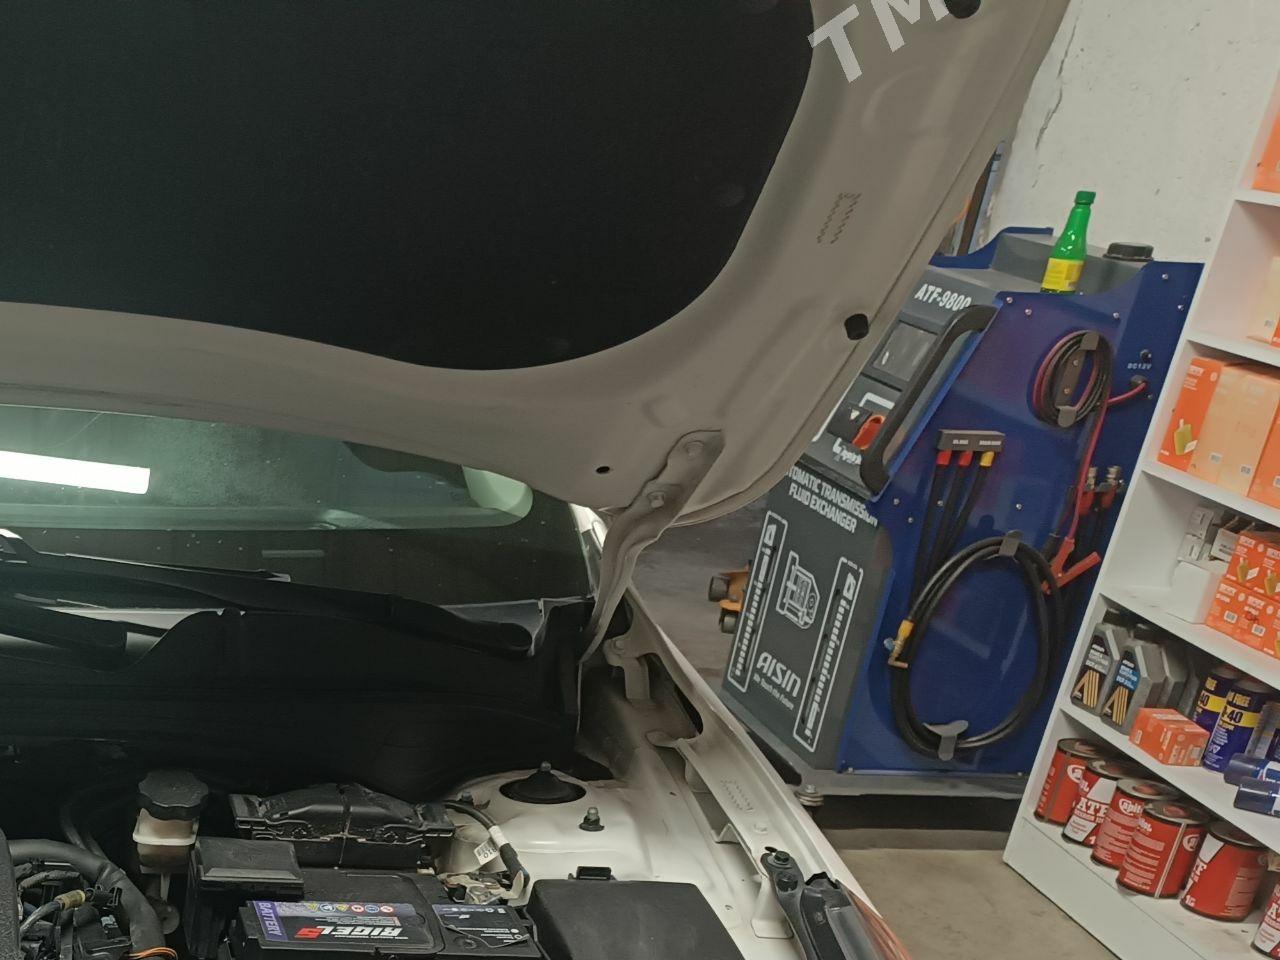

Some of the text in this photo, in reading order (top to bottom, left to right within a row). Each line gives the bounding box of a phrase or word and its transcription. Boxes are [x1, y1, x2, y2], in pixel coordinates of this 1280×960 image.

[914, 283, 972, 312] ATF-9800
[788, 481, 857, 534] FLUID EXCHANGER
[756, 651, 802, 698] AISIN
[257, 900, 283, 937] BATTERY
